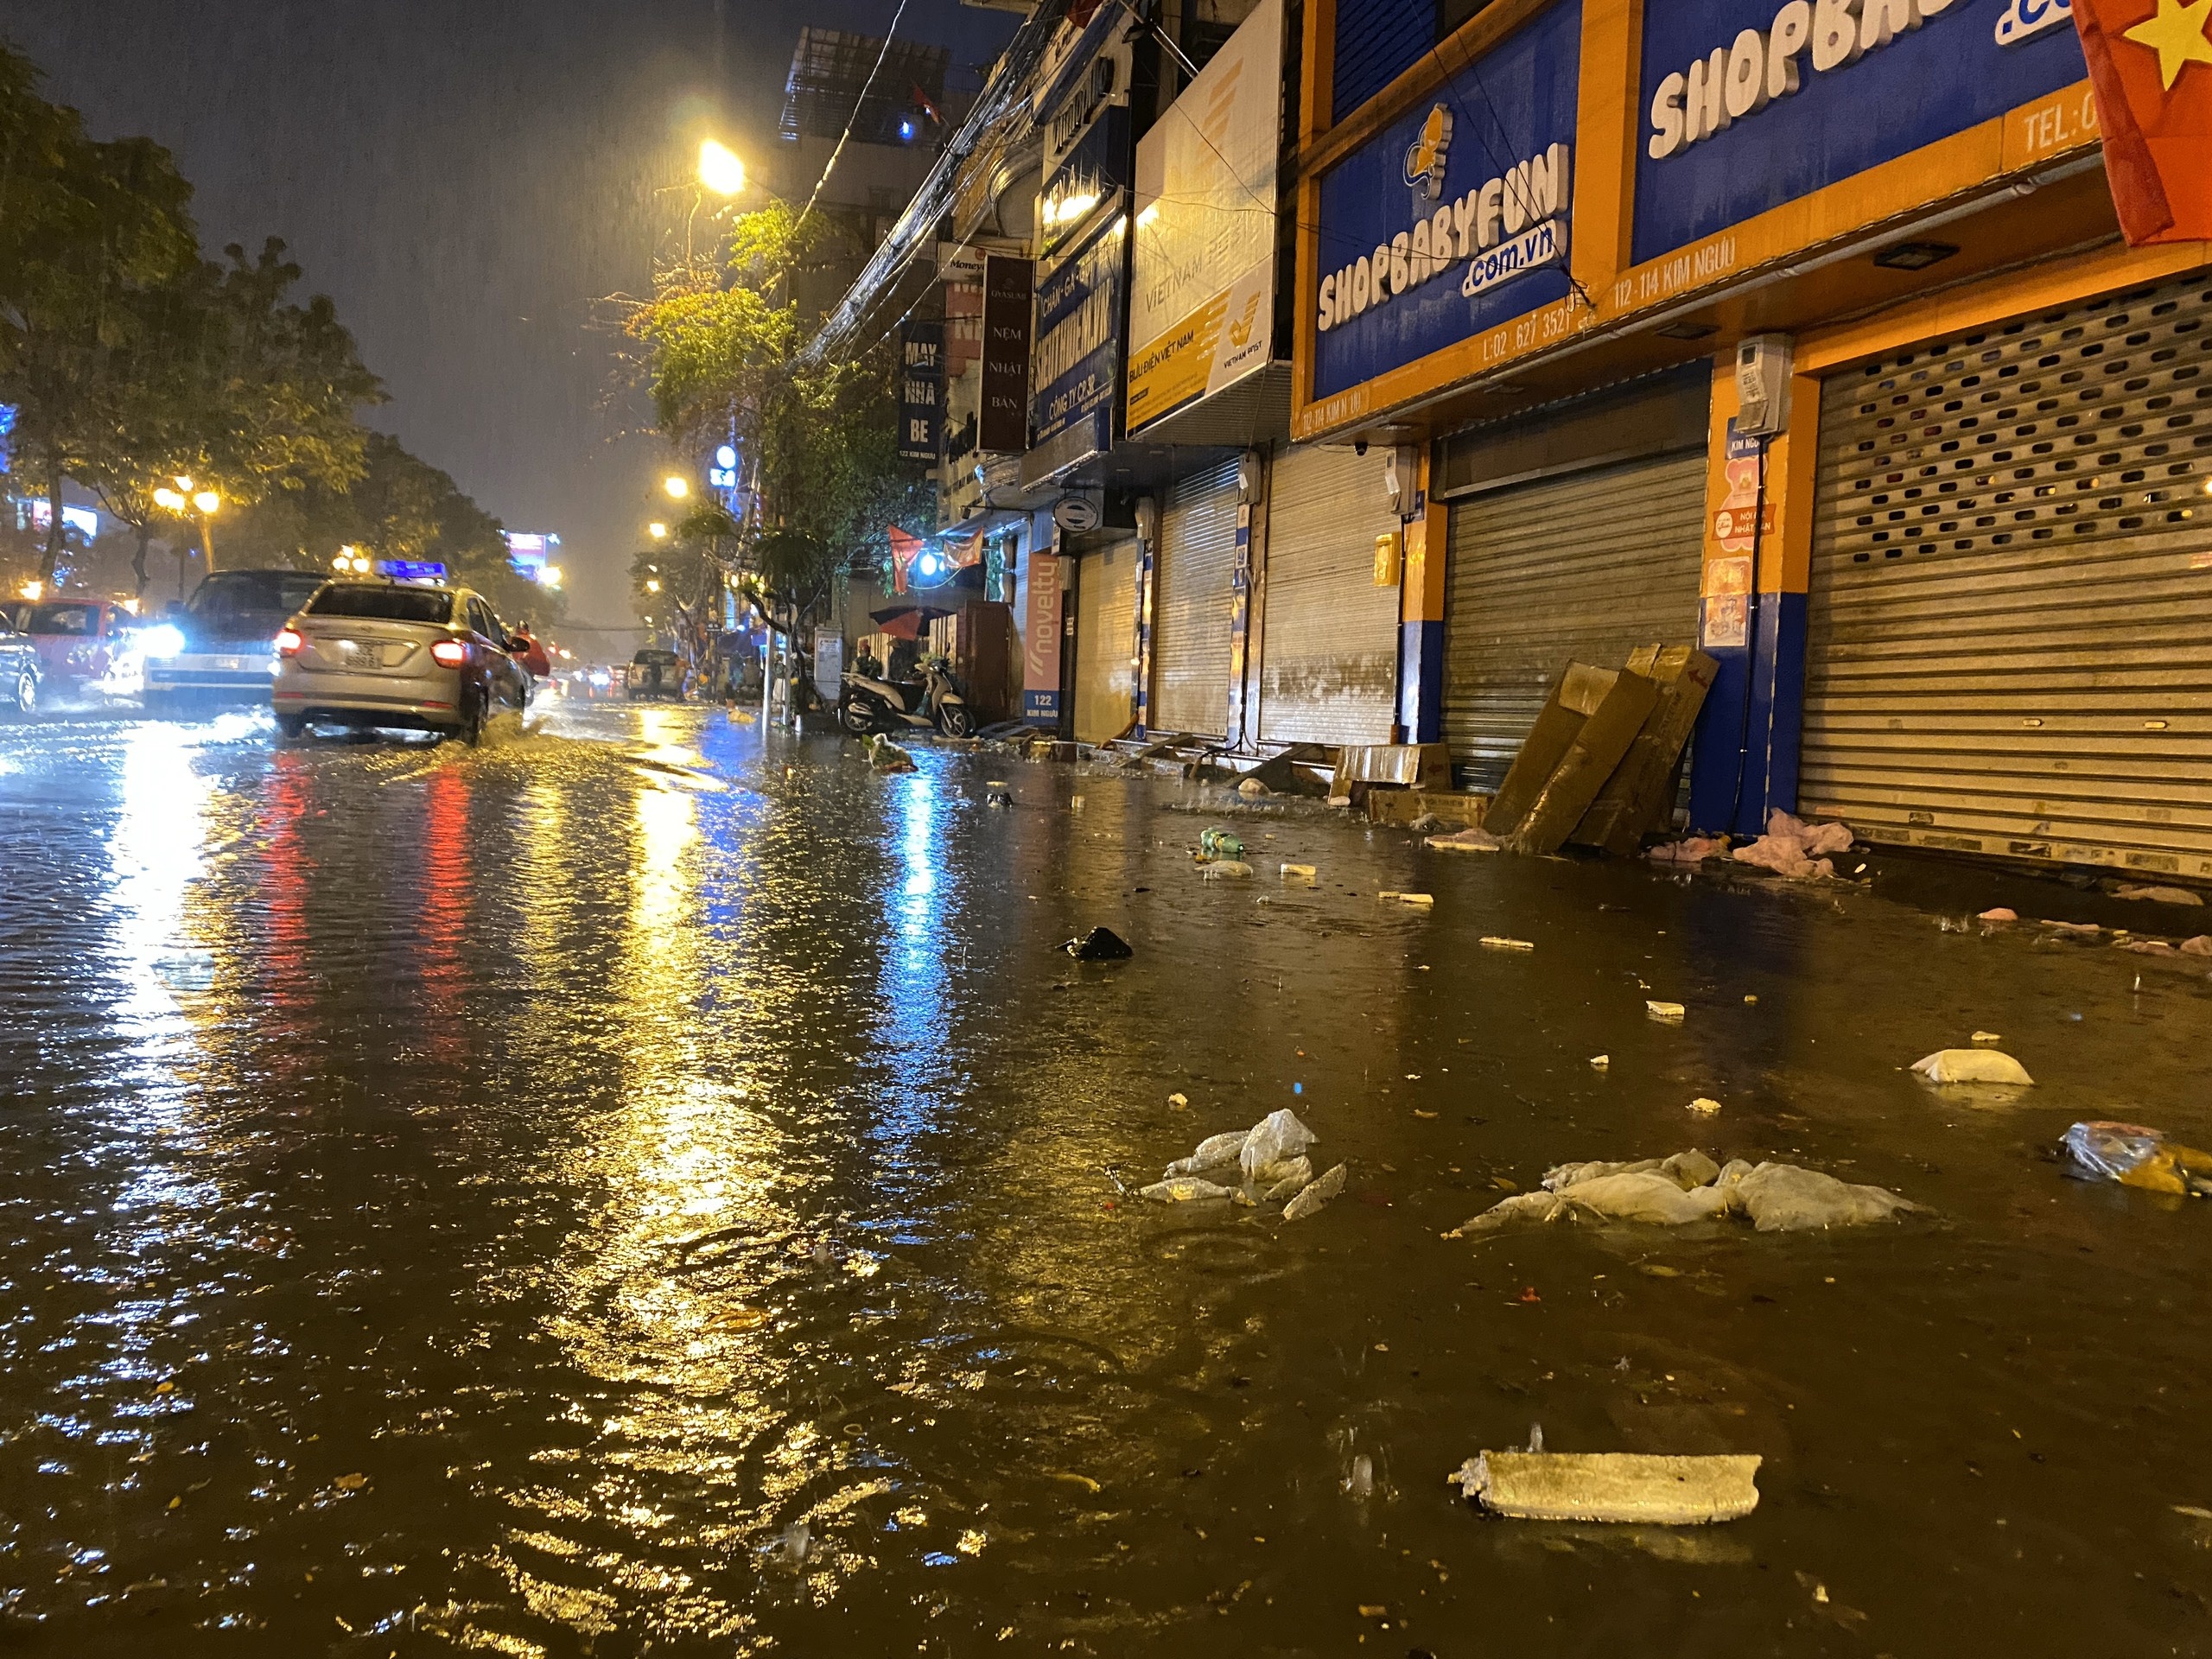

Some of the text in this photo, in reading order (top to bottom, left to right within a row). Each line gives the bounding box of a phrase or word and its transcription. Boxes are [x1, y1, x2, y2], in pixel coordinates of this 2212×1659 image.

[1649, 0, 1955, 159] SHOPB
[1318, 142, 1559, 332] SHOPBABYFUN
[1465, 226, 1554, 291] .com.vn
[1662, 254, 1691, 292] KIM
[1146, 249, 1203, 314] VIETNAM
[905, 341, 938, 367] MAY
[1176, 329, 1194, 353] NAM
[1224, 349, 1246, 369] VIETNAM
[1326, 399, 1340, 423] KIM
[1731, 439, 1744, 452] KIM
[1031, 561, 1058, 654] novelty
[1034, 695, 1052, 706] 122
